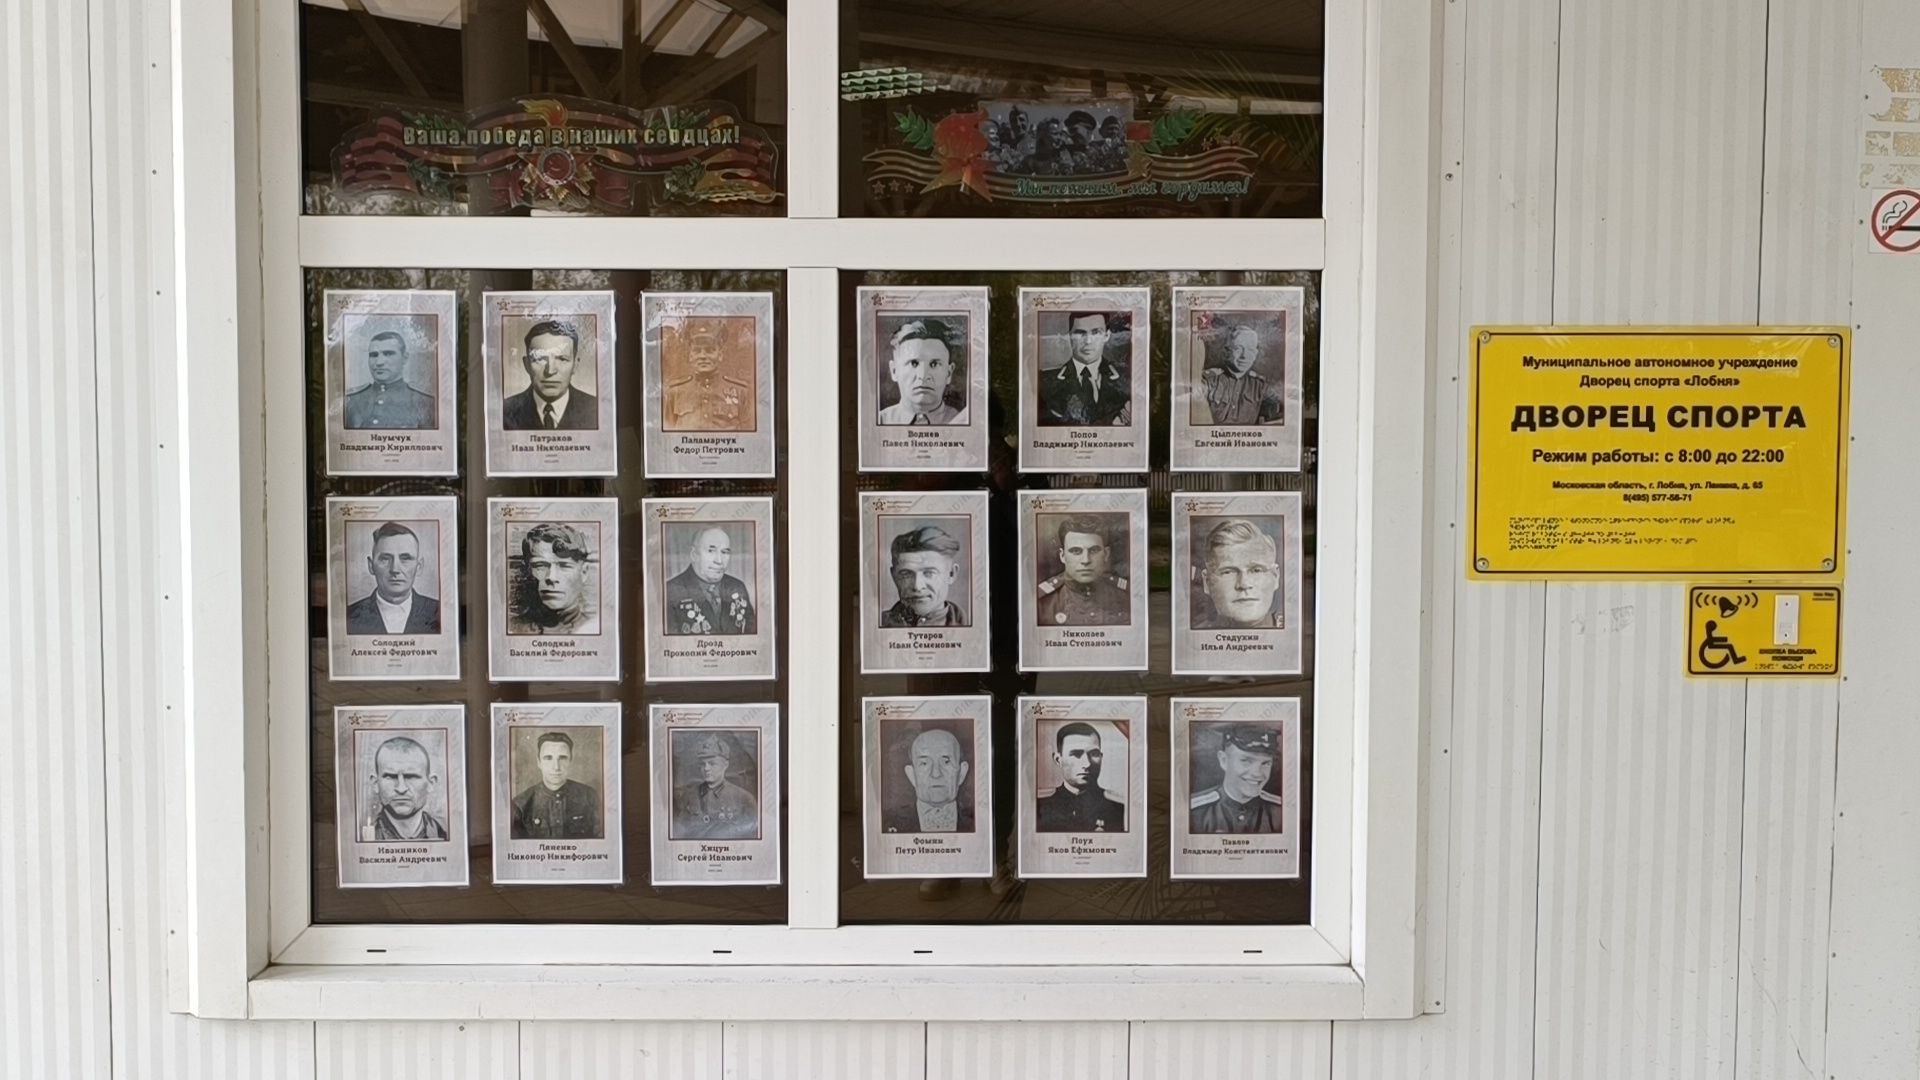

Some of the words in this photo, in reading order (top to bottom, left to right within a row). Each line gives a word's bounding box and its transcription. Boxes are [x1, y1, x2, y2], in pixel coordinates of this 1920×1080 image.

[403, 126, 460, 146] Ваша
[466, 126, 544, 147] победа
[550, 126, 566, 145] в
[570, 126, 638, 145] наших
[644, 126, 741, 147] сердцах!
[1522, 356, 1631, 369] Муниципальное
[1634, 357, 1714, 368] автономное
[1718, 357, 1798, 370] учреждение
[1579, 375, 1631, 388] Дворец
[1634, 376, 1680, 388] спорта
[1684, 375, 1740, 388] «Лобня»
[1511, 406, 1656, 431] ДВОРЕЦ
[1667, 406, 1806, 428] СПОРТА
[371, 434, 411, 442] Наумчук
[1033, 441, 1079, 449] Владимир
[1195, 439, 1232, 447] Евгений
[340, 443, 385, 452] Владимир
[387, 443, 442, 452] Кириллович
[673, 446, 700, 454] Федор
[1532, 449, 1589, 462] Режим
[1592, 449, 1659, 465] работы:
[1664, 452, 1674, 462] с
[1678, 449, 1711, 462] 8:00
[1716, 452, 1738, 465] до
[1742, 449, 1784, 463] 22:00
[1608, 481, 1647, 490] область,
[697, 640, 723, 648] Дрозд
[389, 649, 437, 657] Федотович
[550, 650, 597, 658] Федорович
[664, 649, 707, 658] Прокопий
[709, 649, 757, 657] Федорович
[399, 856, 447, 864] Андреевич
[548, 853, 608, 861] Никифорович
[678, 854, 707, 862] Сергей
